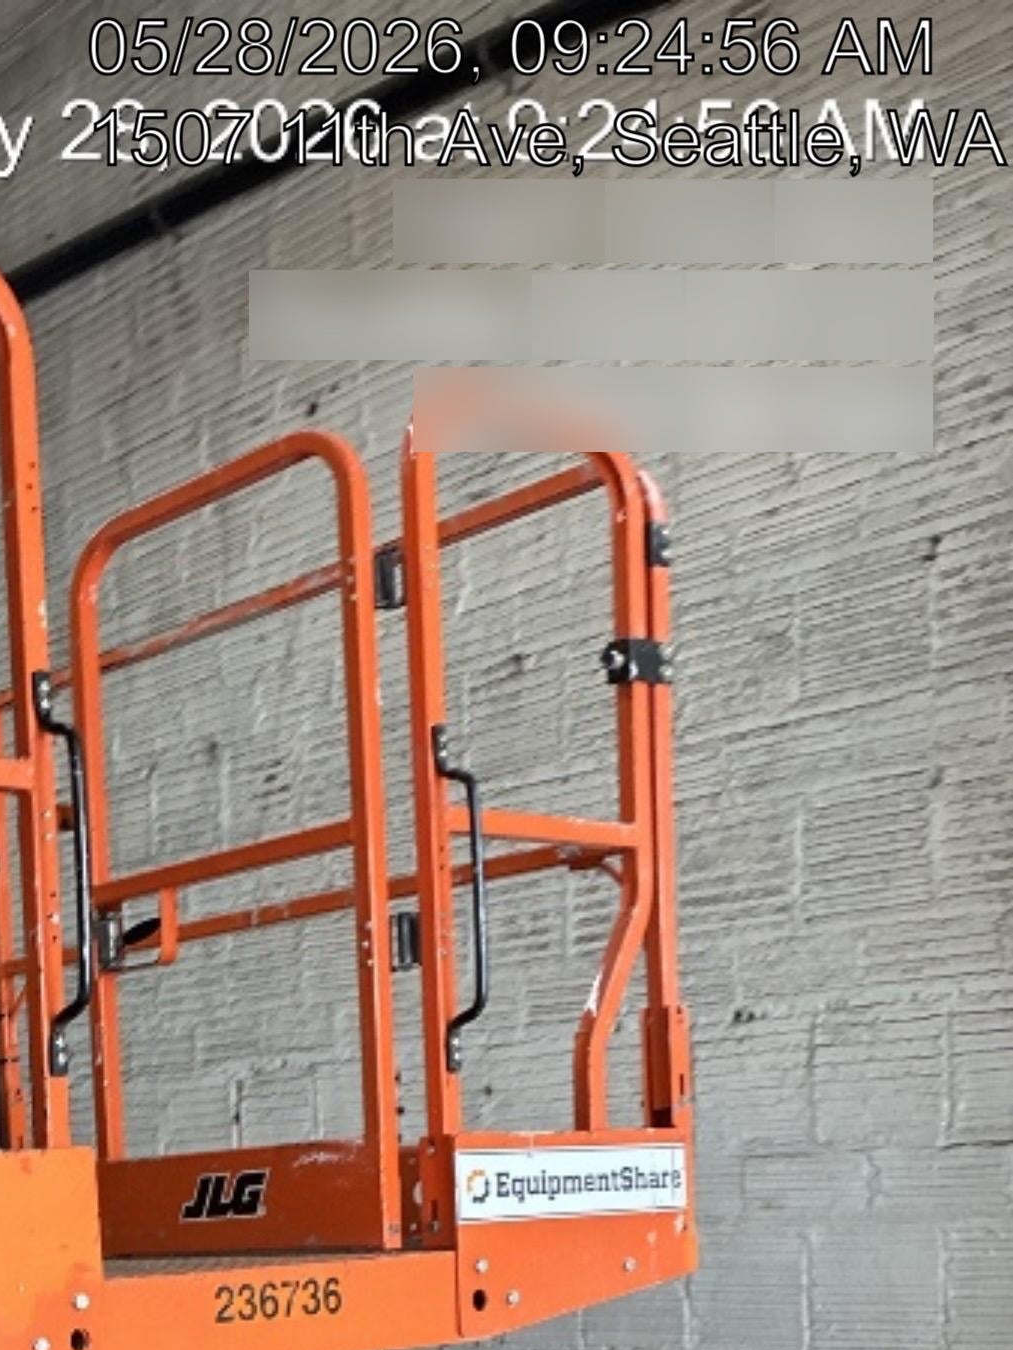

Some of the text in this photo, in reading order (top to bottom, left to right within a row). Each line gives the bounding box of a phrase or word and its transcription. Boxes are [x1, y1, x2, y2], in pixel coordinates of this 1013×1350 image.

[180, 1169, 270, 1222] JLG
[495, 1166, 681, 1203] EquipmentShare
[214, 1277, 342, 1324] 236736
